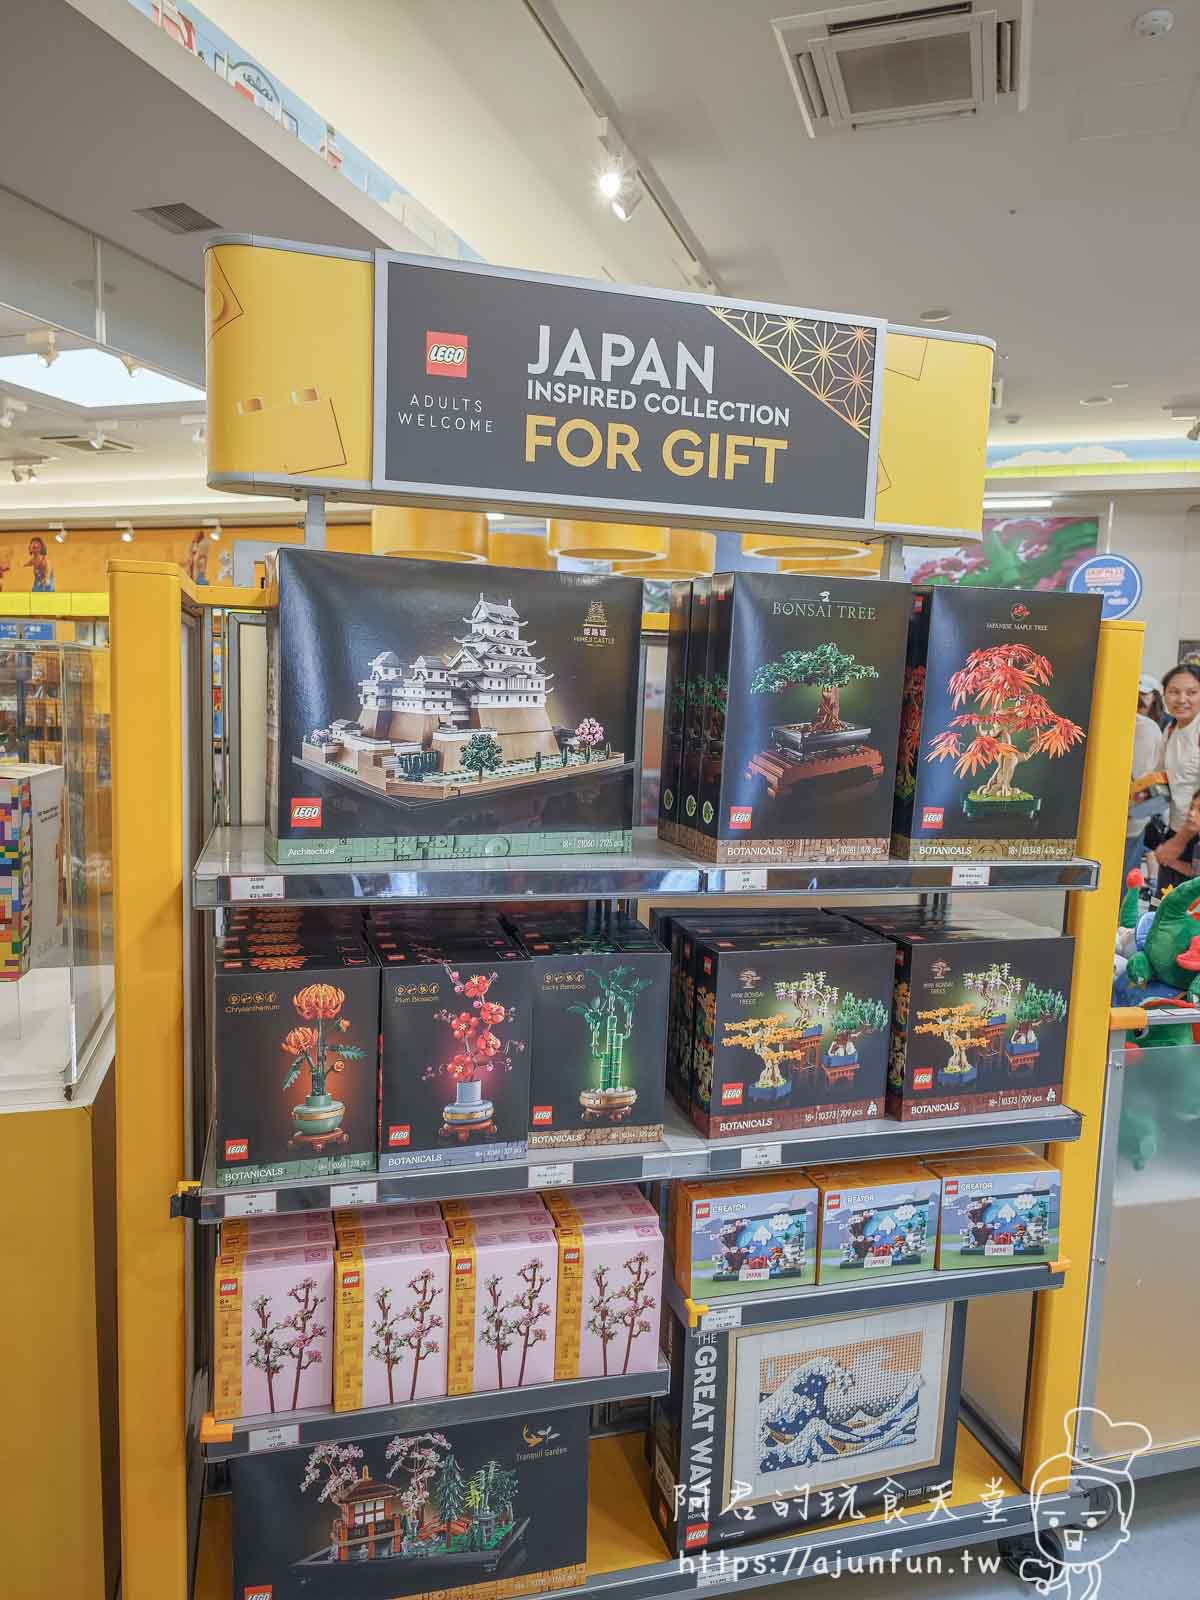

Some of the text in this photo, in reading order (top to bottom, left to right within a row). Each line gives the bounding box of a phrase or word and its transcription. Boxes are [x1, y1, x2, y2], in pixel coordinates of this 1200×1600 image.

[429, 344, 466, 365] LEGO
[527, 324, 715, 394] JAPAN
[409, 393, 482, 413] ADULTS
[527, 379, 791, 428] INSPIRED COLLECTION
[398, 410, 494, 433] WELCOME
[524, 413, 789, 485] FOR GIFT
[772, 601, 877, 621] BONSAI TREE
[292, 805, 321, 819] LEGO
[731, 812, 752, 824] LEGO
[923, 812, 944, 824] LEGO
[287, 846, 337, 858] Architecture
[727, 846, 783, 857] BOTANICALS
[919, 845, 973, 857] BOTANICALS
[913, 1072, 933, 1084] LEGO
[721, 1087, 743, 1099] LEGO
[534, 1110, 552, 1120] LEGO
[911, 1102, 960, 1115] BOTANICALS
[818, 1111, 836, 1122] 10373
[840, 1109, 852, 1119] 709
[852, 1109, 863, 1118] pcs
[719, 1118, 773, 1132] BOTANICALS
[389, 1131, 410, 1141] LEGO
[531, 1134, 583, 1144] BOTANICALS
[226, 1144, 248, 1155] LEGO
[387, 1153, 443, 1167] BOTANICALS
[224, 1167, 284, 1182] BOTANICALS
[961, 1182, 993, 1192] CREATOR
[697, 1333, 717, 1345] THE
[691, 1345, 717, 1432] GREAT
[687, 1440, 712, 1514] WAVE
[687, 1529, 707, 1541] LEGO
